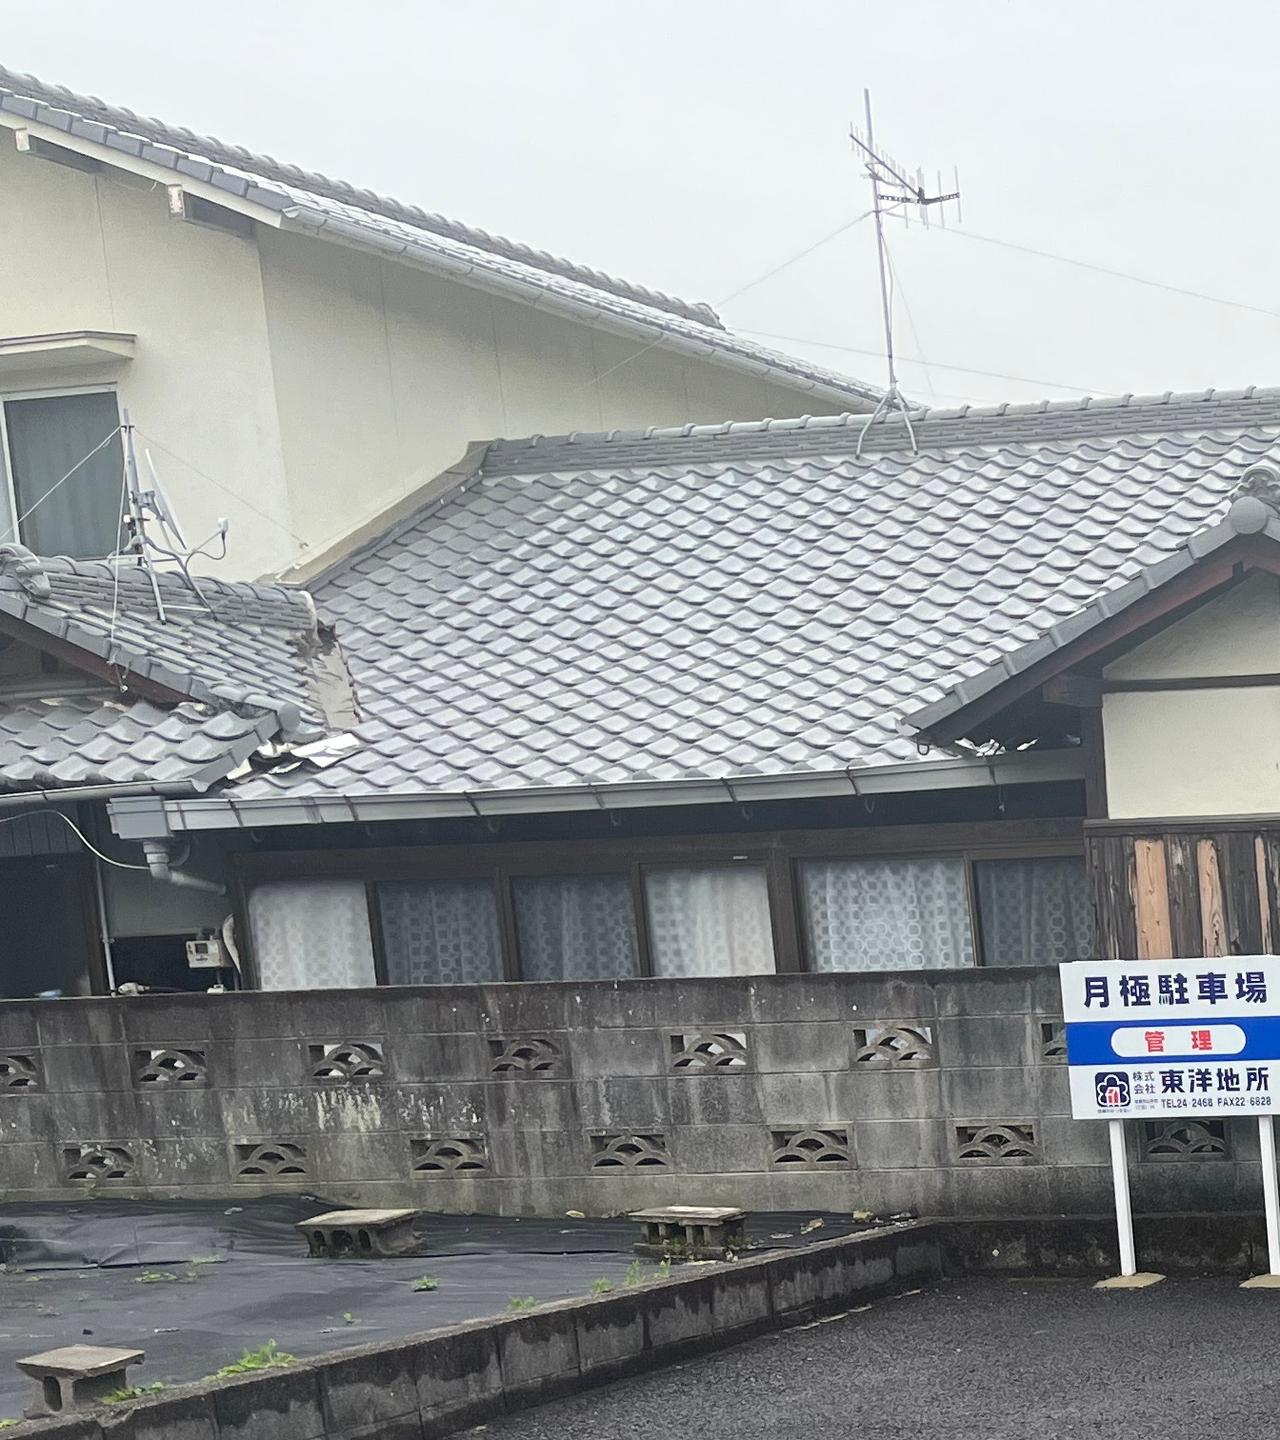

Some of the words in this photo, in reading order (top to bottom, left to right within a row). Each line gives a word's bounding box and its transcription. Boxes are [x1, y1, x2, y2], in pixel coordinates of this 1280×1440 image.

[1084, 972, 1267, 1008] 月極駐車場
[1158, 1067, 1270, 1094] 東洋地所
